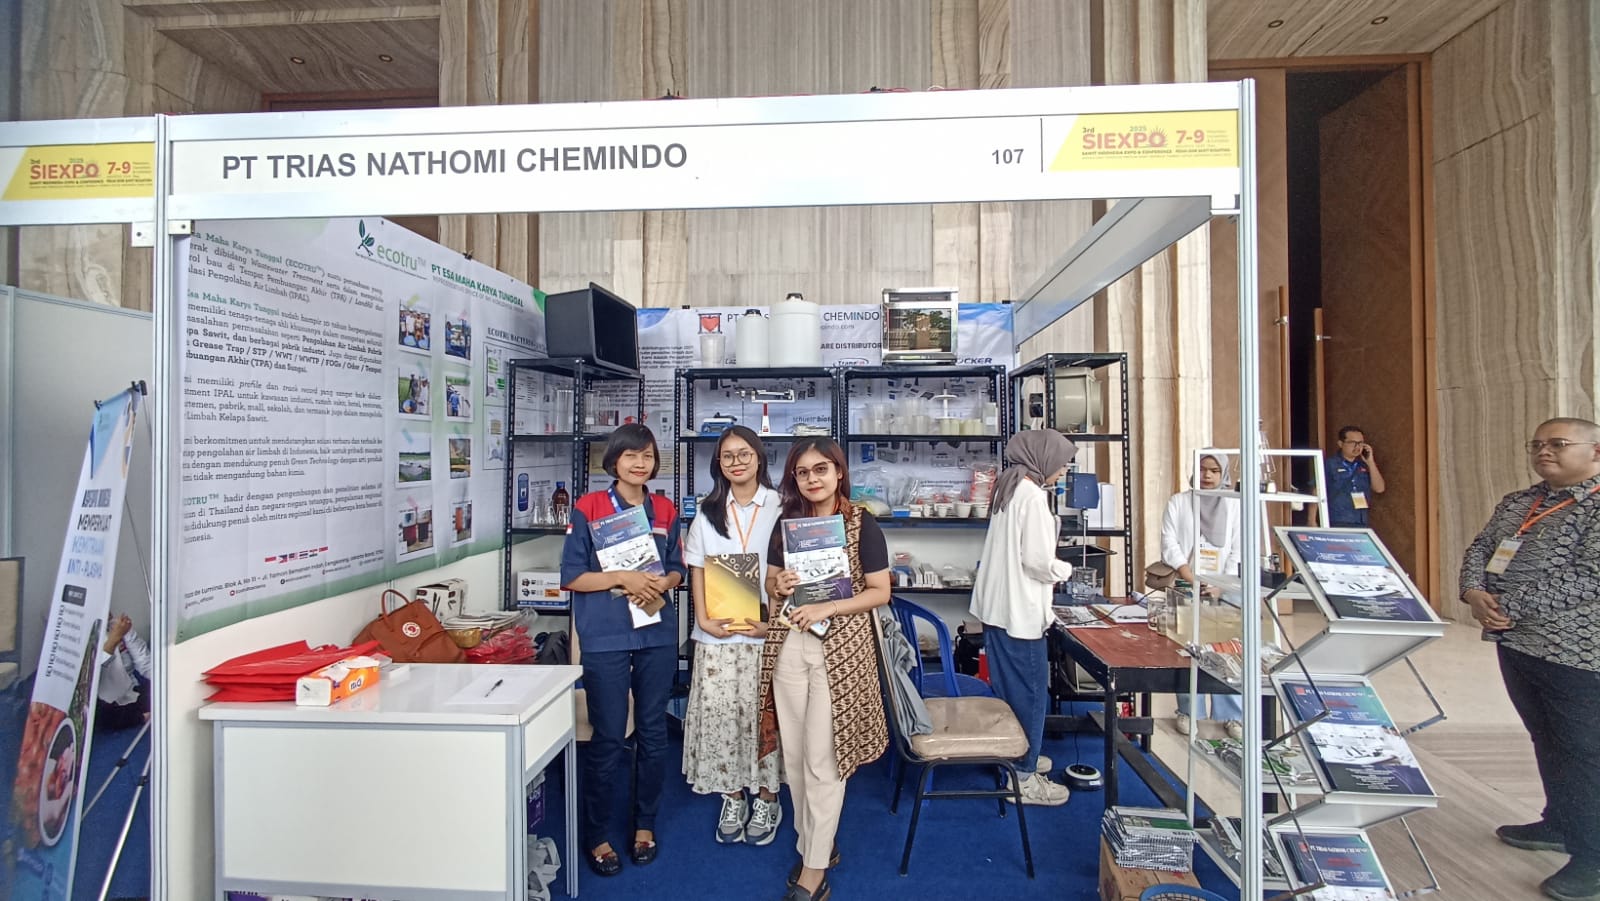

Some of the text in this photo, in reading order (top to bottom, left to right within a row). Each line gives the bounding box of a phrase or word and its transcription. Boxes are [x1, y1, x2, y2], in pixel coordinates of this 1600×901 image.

[1082, 131, 1167, 149] SIEXPO
[1175, 129, 1205, 144] 7-9
[222, 143, 687, 179] PT TRIAS NATHOMI CHEMINDO
[991, 148, 1024, 165] 107
[30, 163, 99, 180] SIEXPO
[107, 161, 131, 175] 7-9
[206, 232, 230, 247] Maha
[232, 241, 253, 255] Karya
[214, 247, 247, 265] dibidang
[206, 256, 222, 268] bau
[227, 262, 235, 271] di
[311, 286, 327, 297] Akhir
[208, 269, 252, 288] Pengolahan
[265, 284, 288, 298] Limbah
[431, 263, 441, 275] PT
[442, 267, 455, 281] ESA
[455, 273, 476, 289] MAHA
[477, 281, 498, 298] KARYA
[498, 289, 524, 307] TUNGGAL
[202, 292, 228, 305] Maha
[230, 297, 252, 310] Karya
[823, 311, 880, 322] CHEMINDO
[192, 338, 223, 350] Grease
[226, 343, 245, 355] Trap
[252, 347, 267, 356] STP
[232, 332, 248, 343] dan
[249, 334, 280, 348] berbagai
[835, 342, 882, 350] DISTRIBUTOR
[227, 355, 249, 366] Akhir
[251, 358, 273, 370] (TPA)
[274, 361, 286, 370] dan
[197, 377, 235, 387] memiliki
[266, 382, 279, 391] dan
[237, 391, 259, 400] untuk
[219, 413, 246, 423] Kelapa
[194, 435, 247, 445] berkomitmen
[197, 447, 244, 458] pengolahan
[257, 447, 281, 456] limbah
[192, 460, 221, 470] dengan
[223, 459, 268, 468] mendukung
[269, 457, 290, 468] penuh
[193, 469, 287, 481] tidak mengandung bahan
[223, 493, 244, 503] hadir
[246, 491, 273, 501] dengan
[209, 504, 243, 516] Thailand
[245, 504, 260, 512] dan
[228, 515, 251, 527] penuh
[251, 513, 268, 523] oleh
[269, 510, 287, 520] mitra
